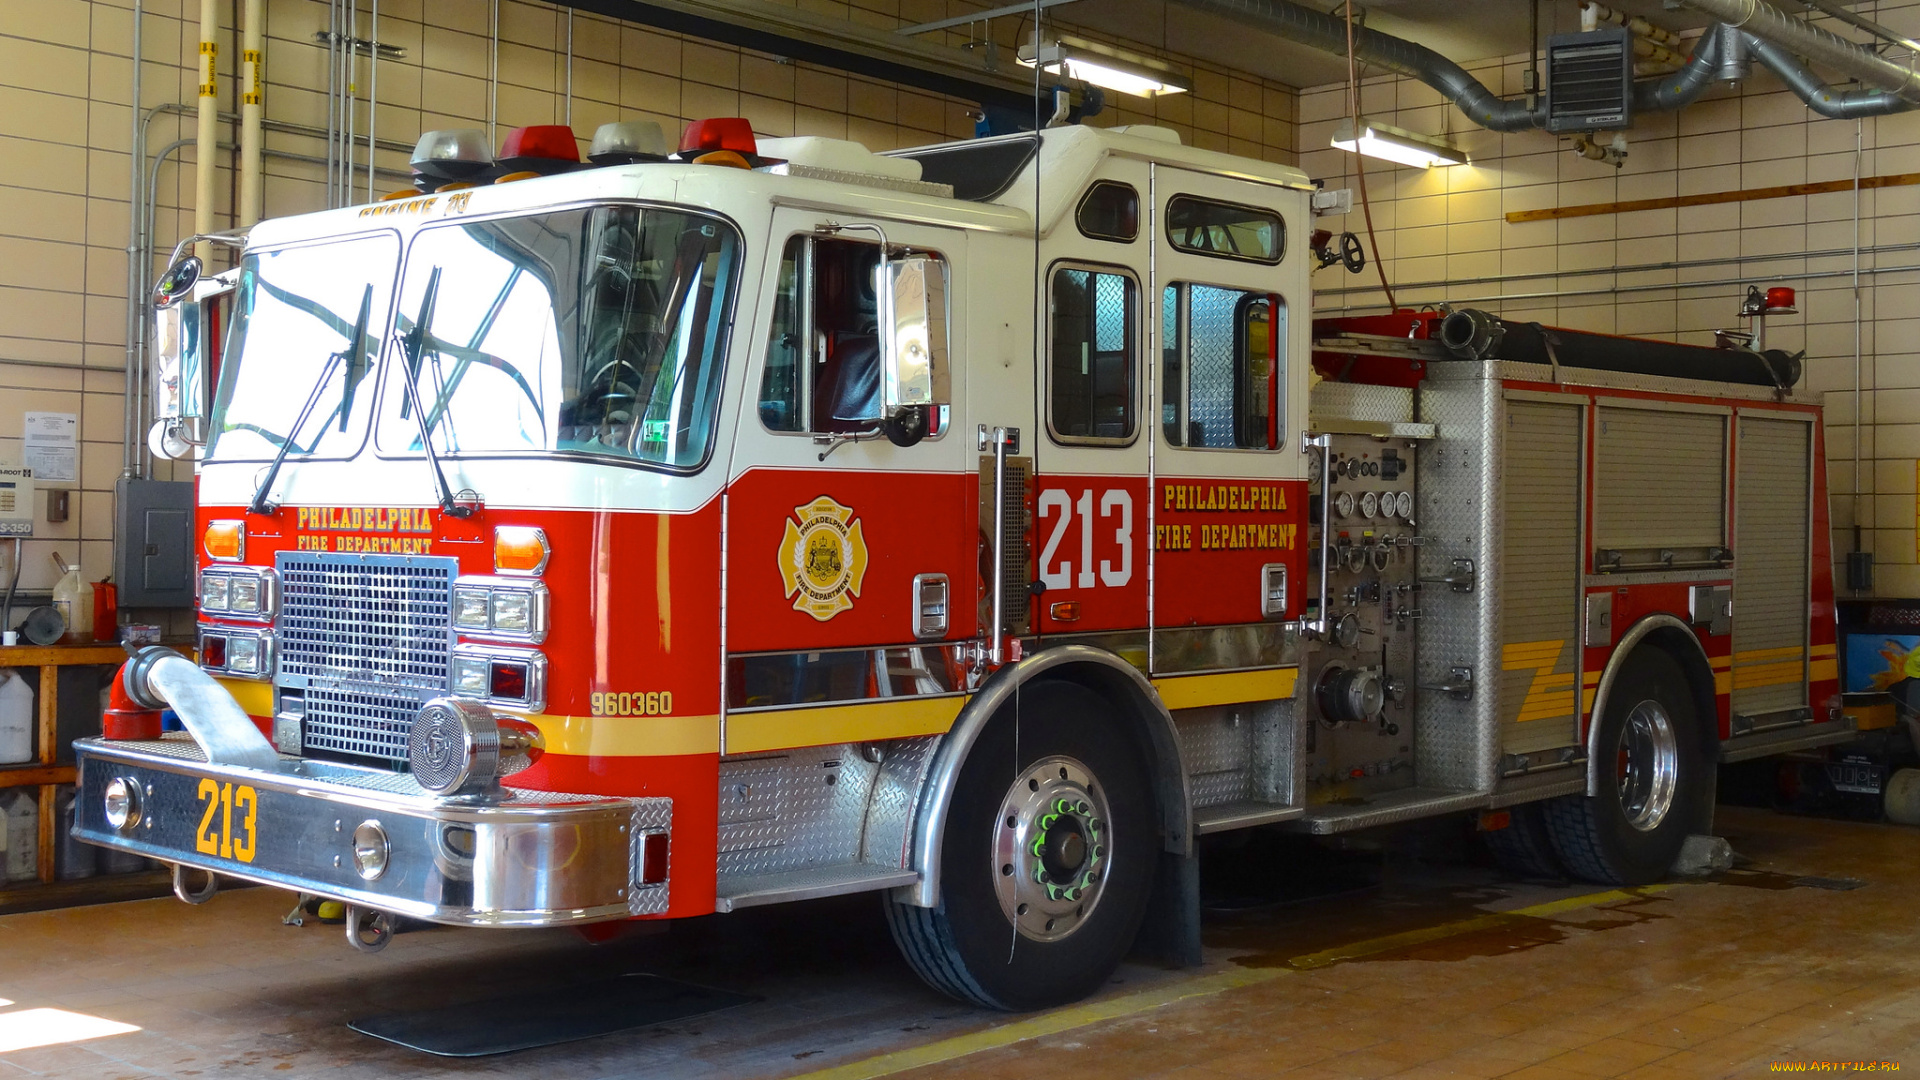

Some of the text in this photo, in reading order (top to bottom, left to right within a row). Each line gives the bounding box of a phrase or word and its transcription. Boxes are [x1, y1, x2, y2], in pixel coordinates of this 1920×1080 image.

[1164, 485, 1287, 511] PHILADELPHIA
[297, 508, 432, 532] PHILADELPHIA
[800, 516, 848, 537] PHILADELPHIA
[297, 536, 432, 554] FIRE DEPARTMENT
[1038, 489, 1132, 590] 213
[1155, 524, 1297, 550] FIRE DEPARTMENT
[796, 574, 851, 601] FIRE DEPARTMENT
[591, 691, 672, 716] 960360
[196, 778, 257, 863] 213
